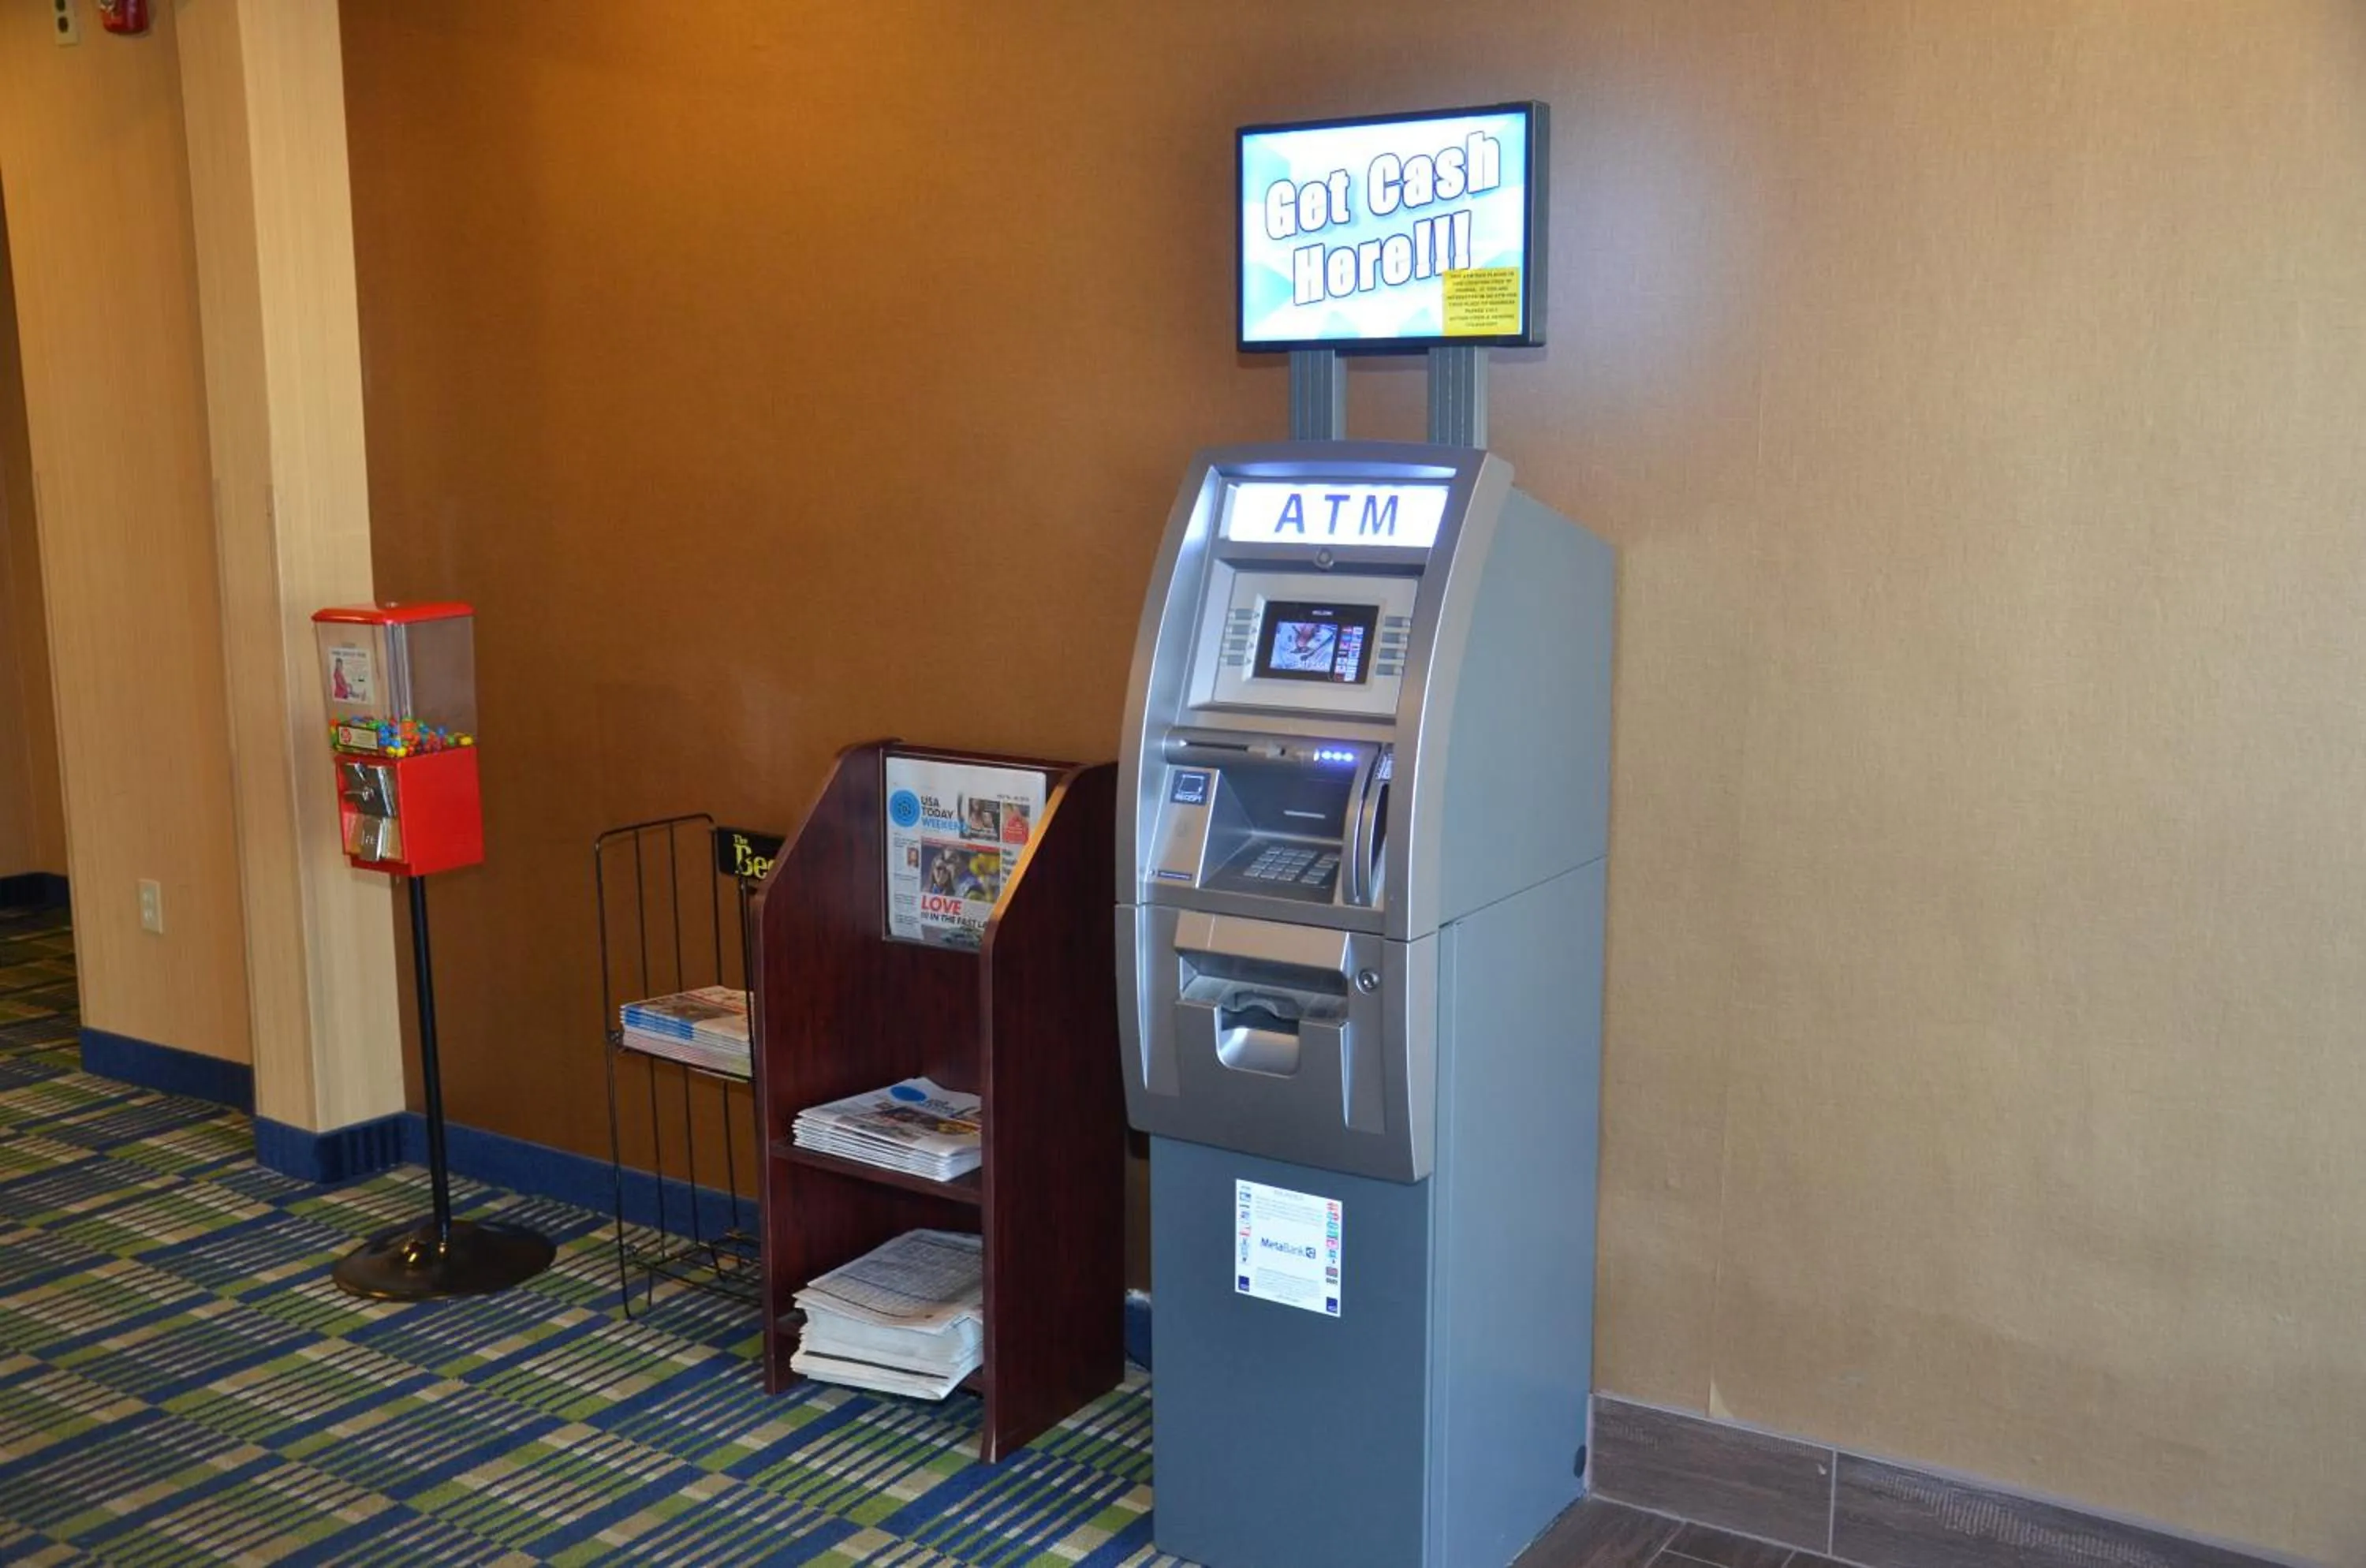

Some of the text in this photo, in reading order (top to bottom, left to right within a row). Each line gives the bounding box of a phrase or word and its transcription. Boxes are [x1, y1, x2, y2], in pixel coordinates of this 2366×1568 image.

[1265, 131, 1501, 240] Get Cash
[1274, 493, 1399, 536] ATM
[920, 795, 939, 808] USA
[921, 805, 954, 819] TODAY
[920, 895, 962, 915] LOVE
